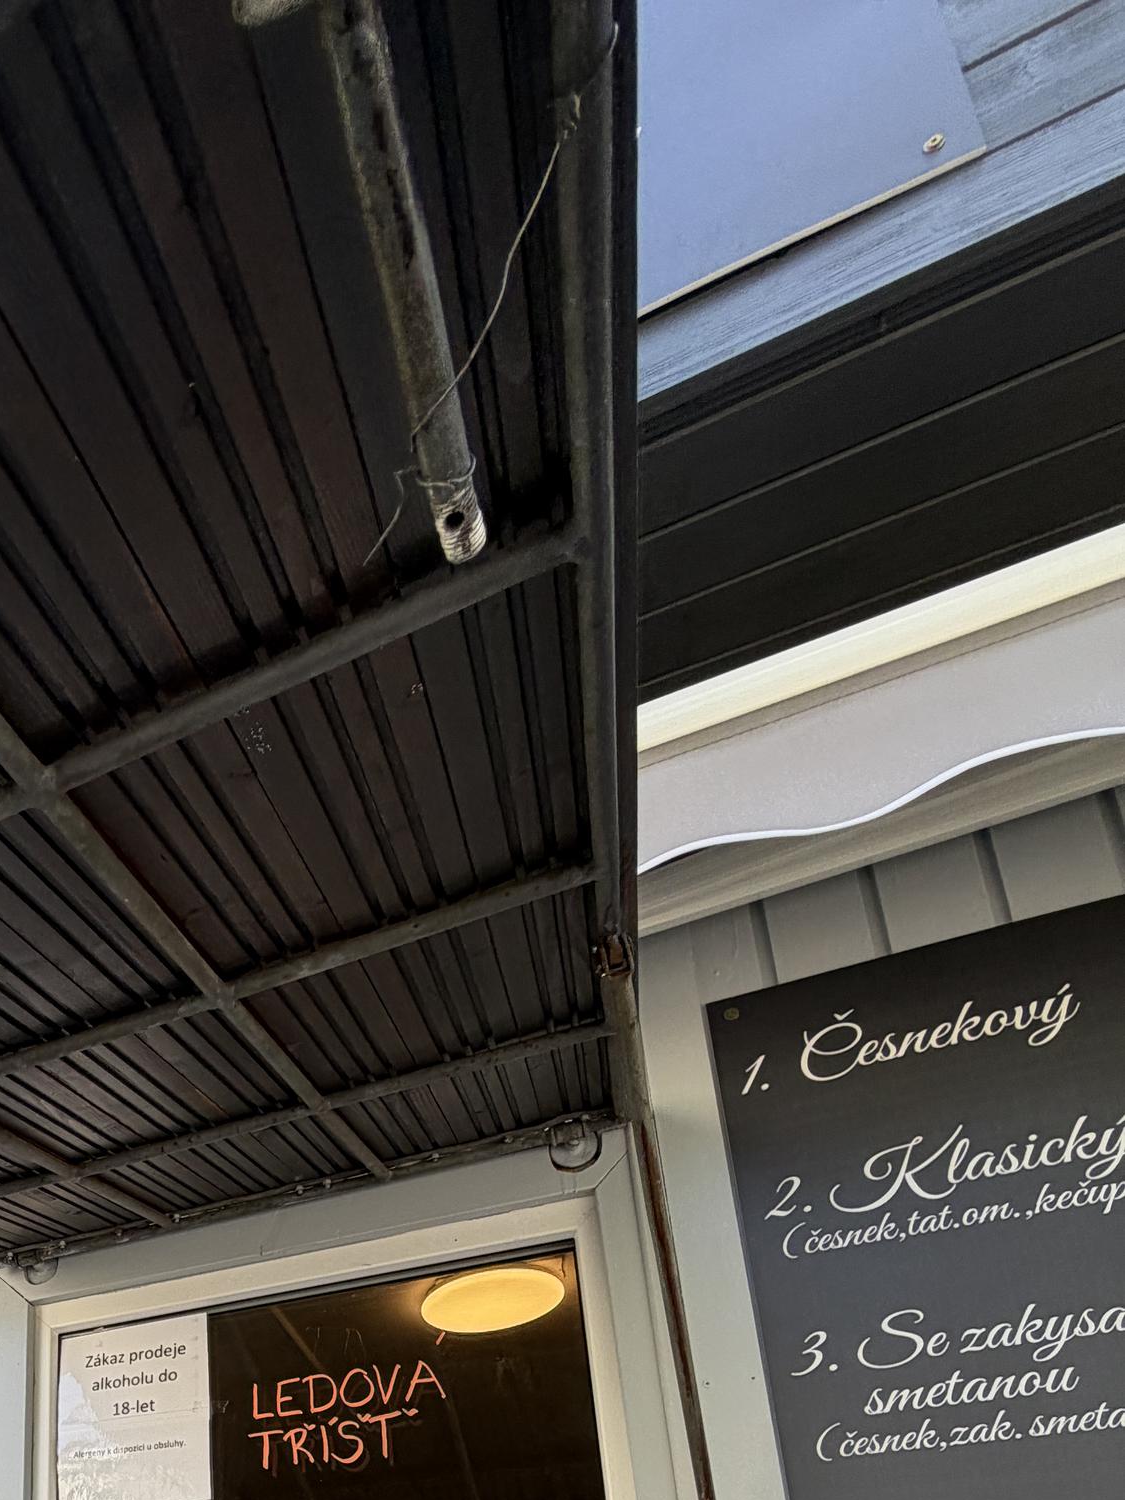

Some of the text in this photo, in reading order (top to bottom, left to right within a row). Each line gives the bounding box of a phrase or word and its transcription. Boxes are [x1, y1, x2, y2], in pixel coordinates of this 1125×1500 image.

[741, 982, 1080, 1095] 1. Česnekový
[765, 1177, 812, 1221] 2.
[85, 1343, 186, 1368] Zákaz prodeje
[791, 1331, 838, 1376] 3.
[857, 1309, 950, 1369] Se
[92, 1368, 178, 1391] alkoholu do
[864, 1366, 1080, 1416] smetanou
[113, 1399, 156, 1416] 18-let
[146, 1443, 152, 1451] u
